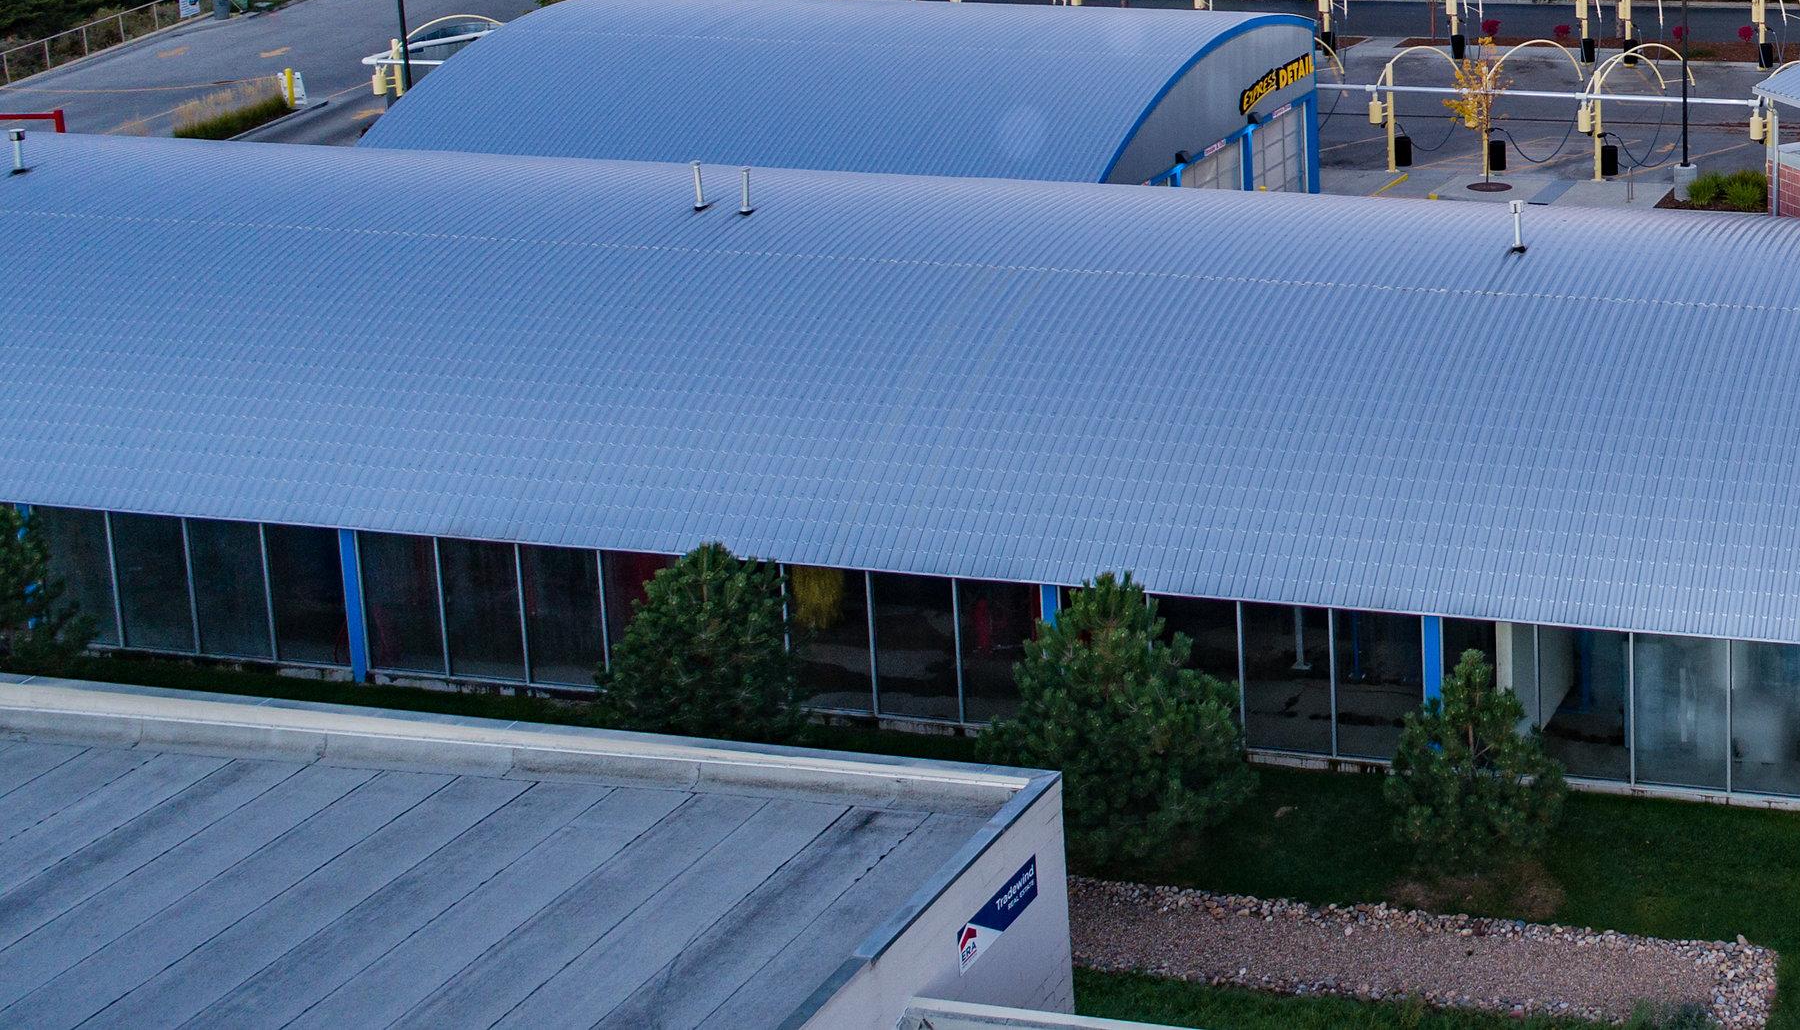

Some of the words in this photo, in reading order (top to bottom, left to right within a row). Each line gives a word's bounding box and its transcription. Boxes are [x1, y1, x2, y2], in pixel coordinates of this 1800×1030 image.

[1243, 70, 1277, 111] EXPRESS
[1279, 54, 1314, 89] DETAIL
[995, 864, 1035, 911] Tradewind
[961, 941, 977, 962] ERA
